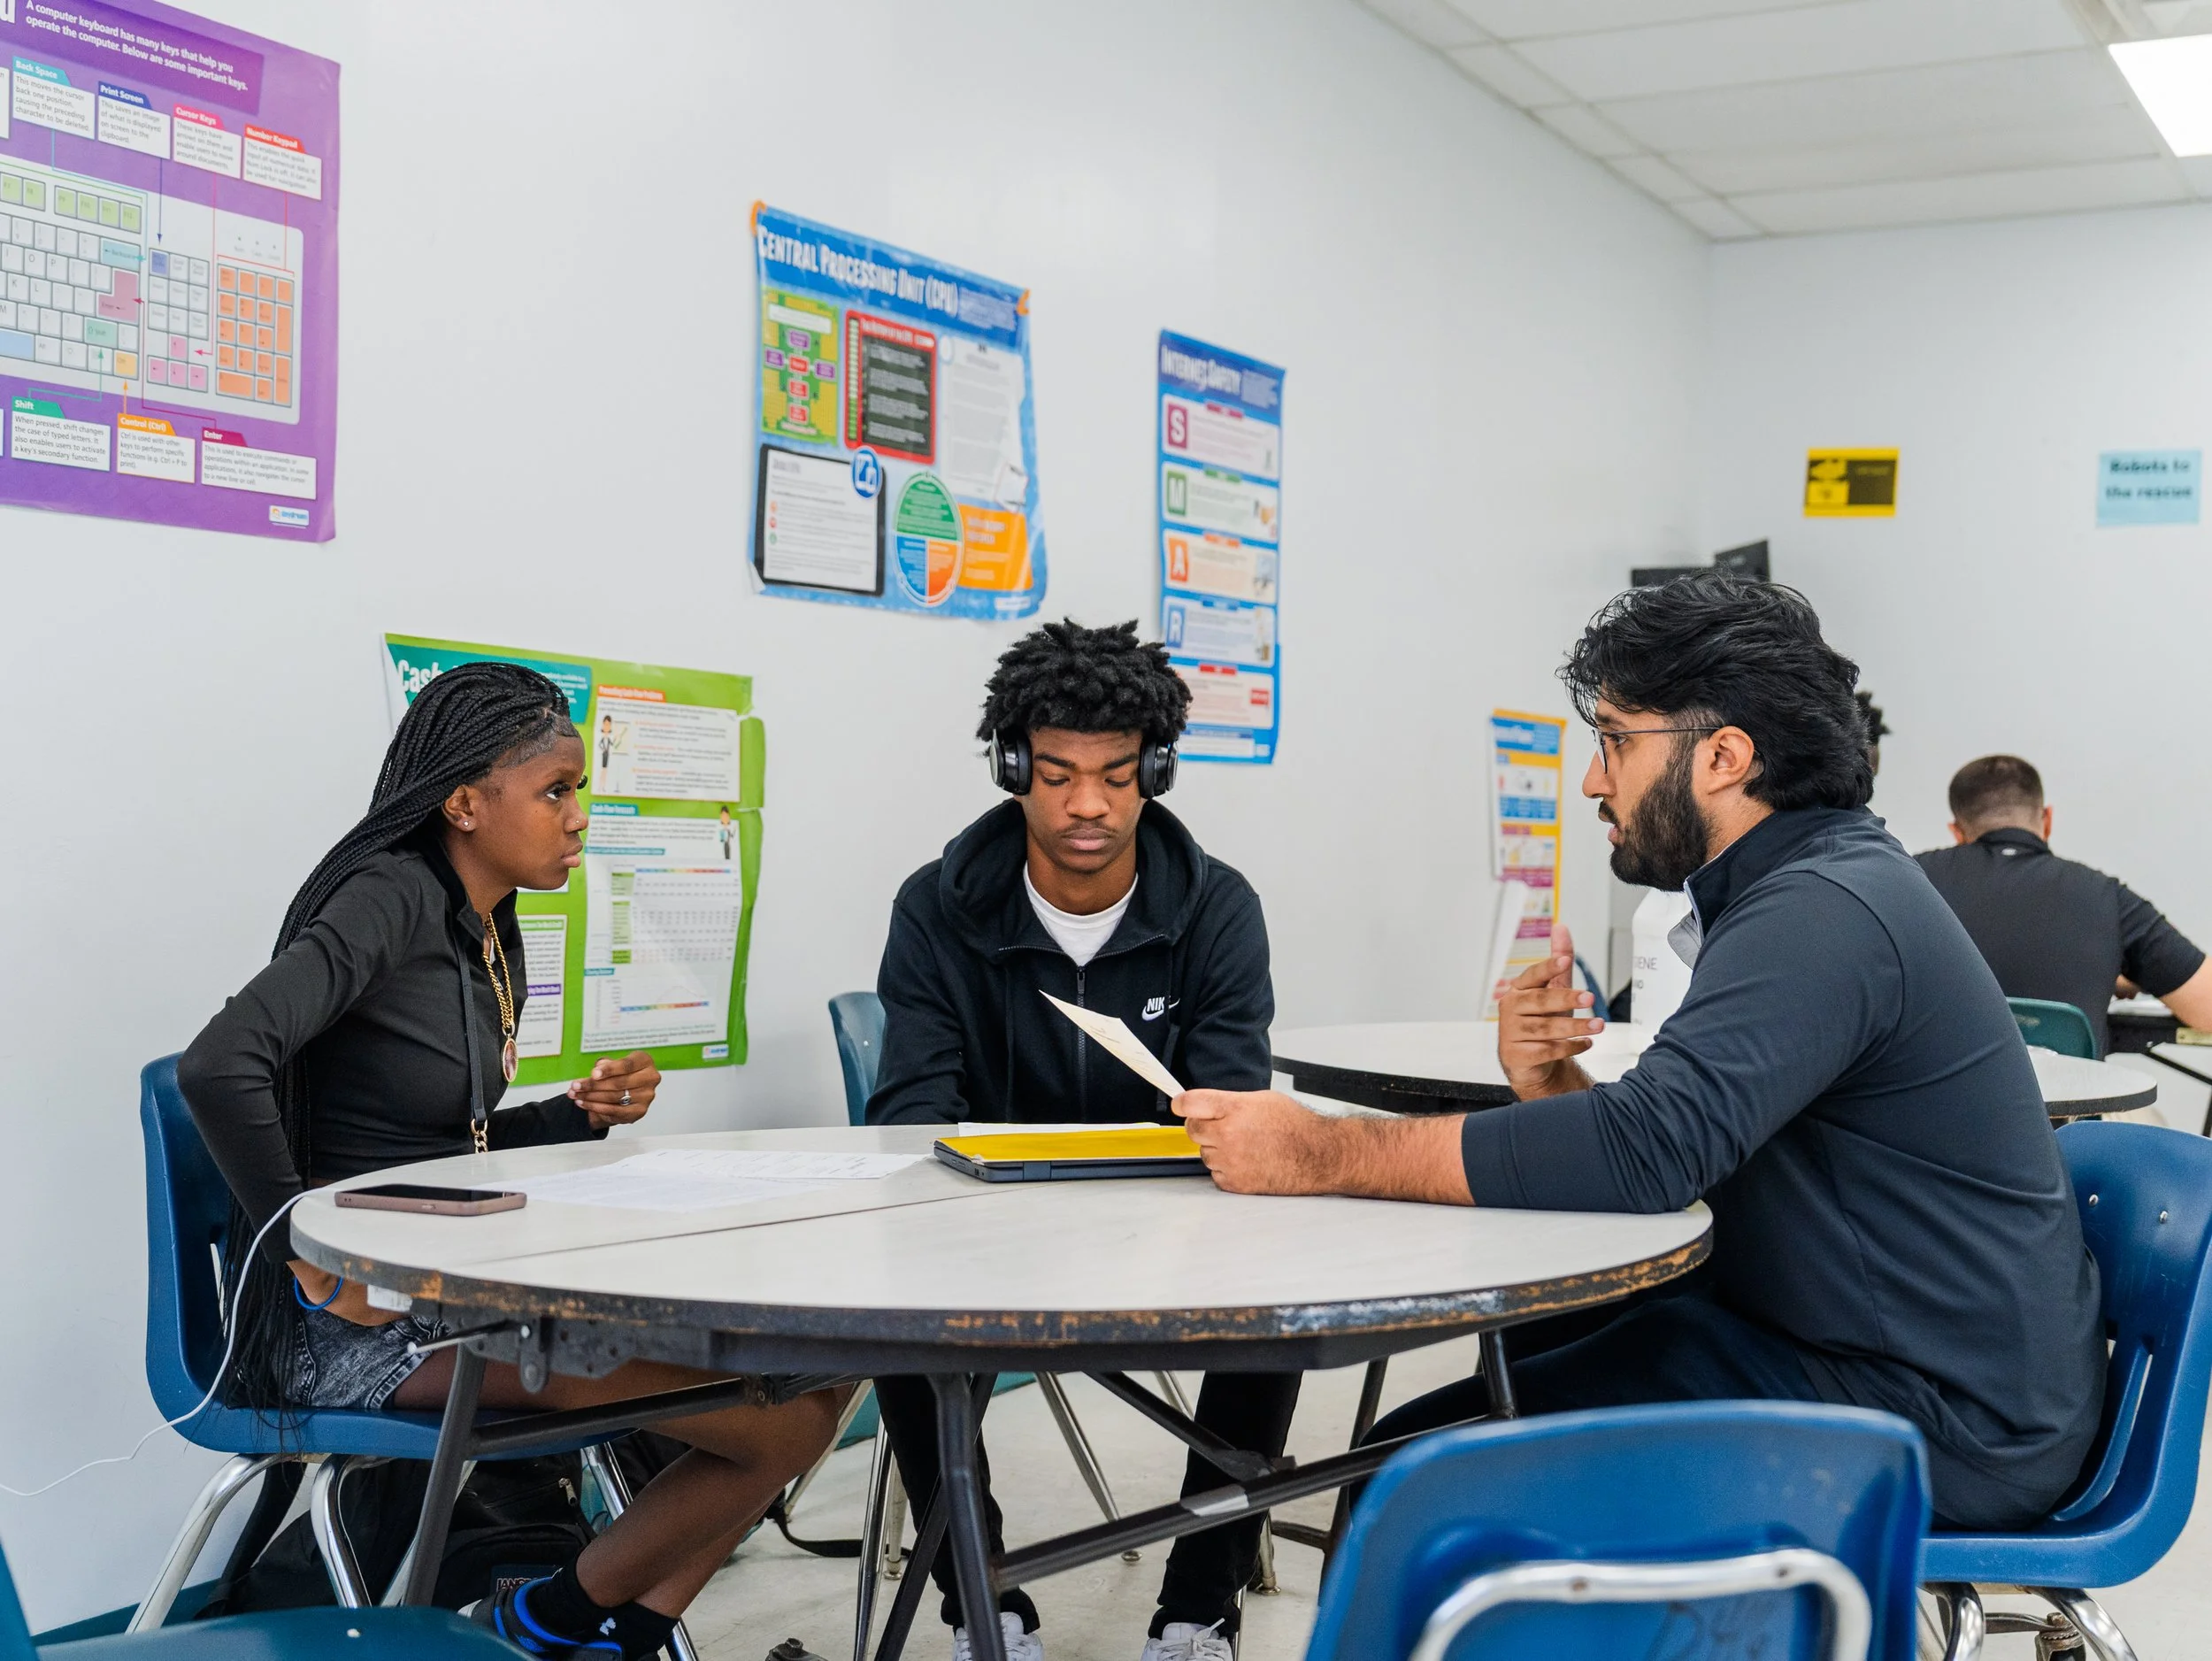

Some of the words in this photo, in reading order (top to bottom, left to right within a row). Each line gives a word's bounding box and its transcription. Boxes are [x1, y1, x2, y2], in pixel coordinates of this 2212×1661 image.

[26, 0, 34, 10] A
[35, 4, 77, 24] computer
[79, 16, 119, 36] keyboard
[119, 28, 134, 42] has
[136, 35, 159, 51] many
[161, 41, 180, 57] keys
[180, 48, 198, 62] that
[199, 54, 217, 69] help
[218, 62, 234, 73] you
[26, 16, 60, 33] operate
[62, 26, 77, 38] the
[79, 32, 120, 51] computer.
[122, 43, 149, 60] Below
[150, 54, 163, 65] are
[165, 58, 186, 72] some
[188, 64, 227, 84] important
[228, 76, 248, 90] keys.
[16, 60, 34, 72] Back
[35, 66, 58, 79] Space
[101, 85, 119, 96] Print
[120, 91, 143, 104] Screen
[757, 224, 819, 273] CENTRAL
[820, 243, 897, 296] PROCESSING
[898, 267, 926, 304] UNIT
[14, 400, 35, 410] Shift
[120, 418, 147, 427] Control
[1171, 409, 1185, 443] S
[204, 430, 223, 440] Enter
[1174, 544, 1186, 575] A
[1147, 996, 1171, 1011] NIK
